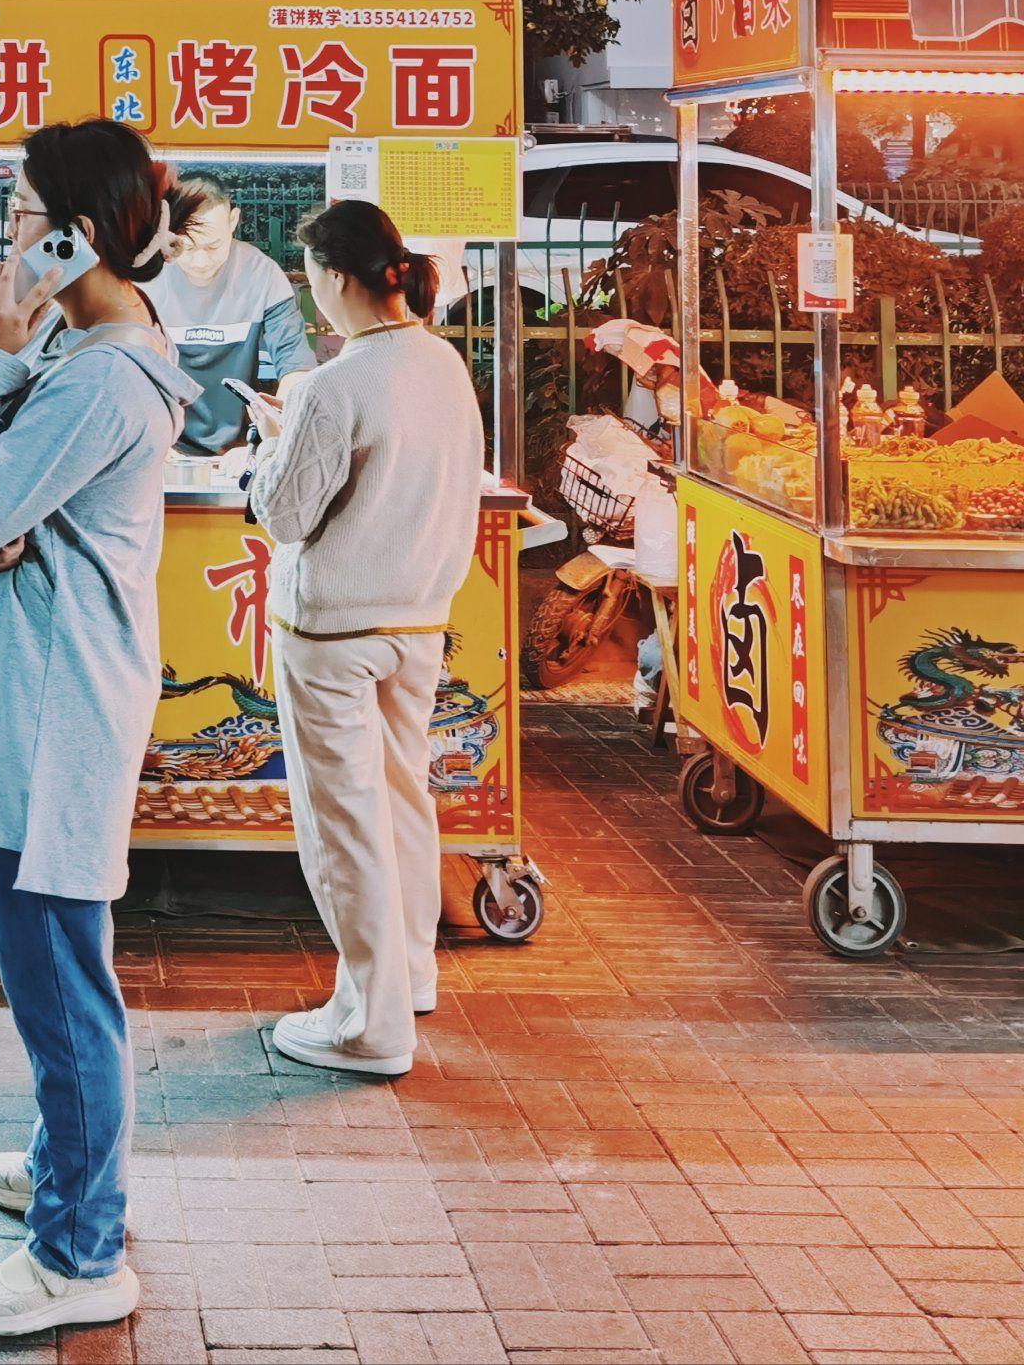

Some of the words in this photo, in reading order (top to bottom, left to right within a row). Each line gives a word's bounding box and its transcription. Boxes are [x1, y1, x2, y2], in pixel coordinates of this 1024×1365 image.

[270, 7, 474, 28] 灌饼教学:13554124752
[111, 46, 143, 122] 东北
[170, 41, 475, 131] 烤冷面
